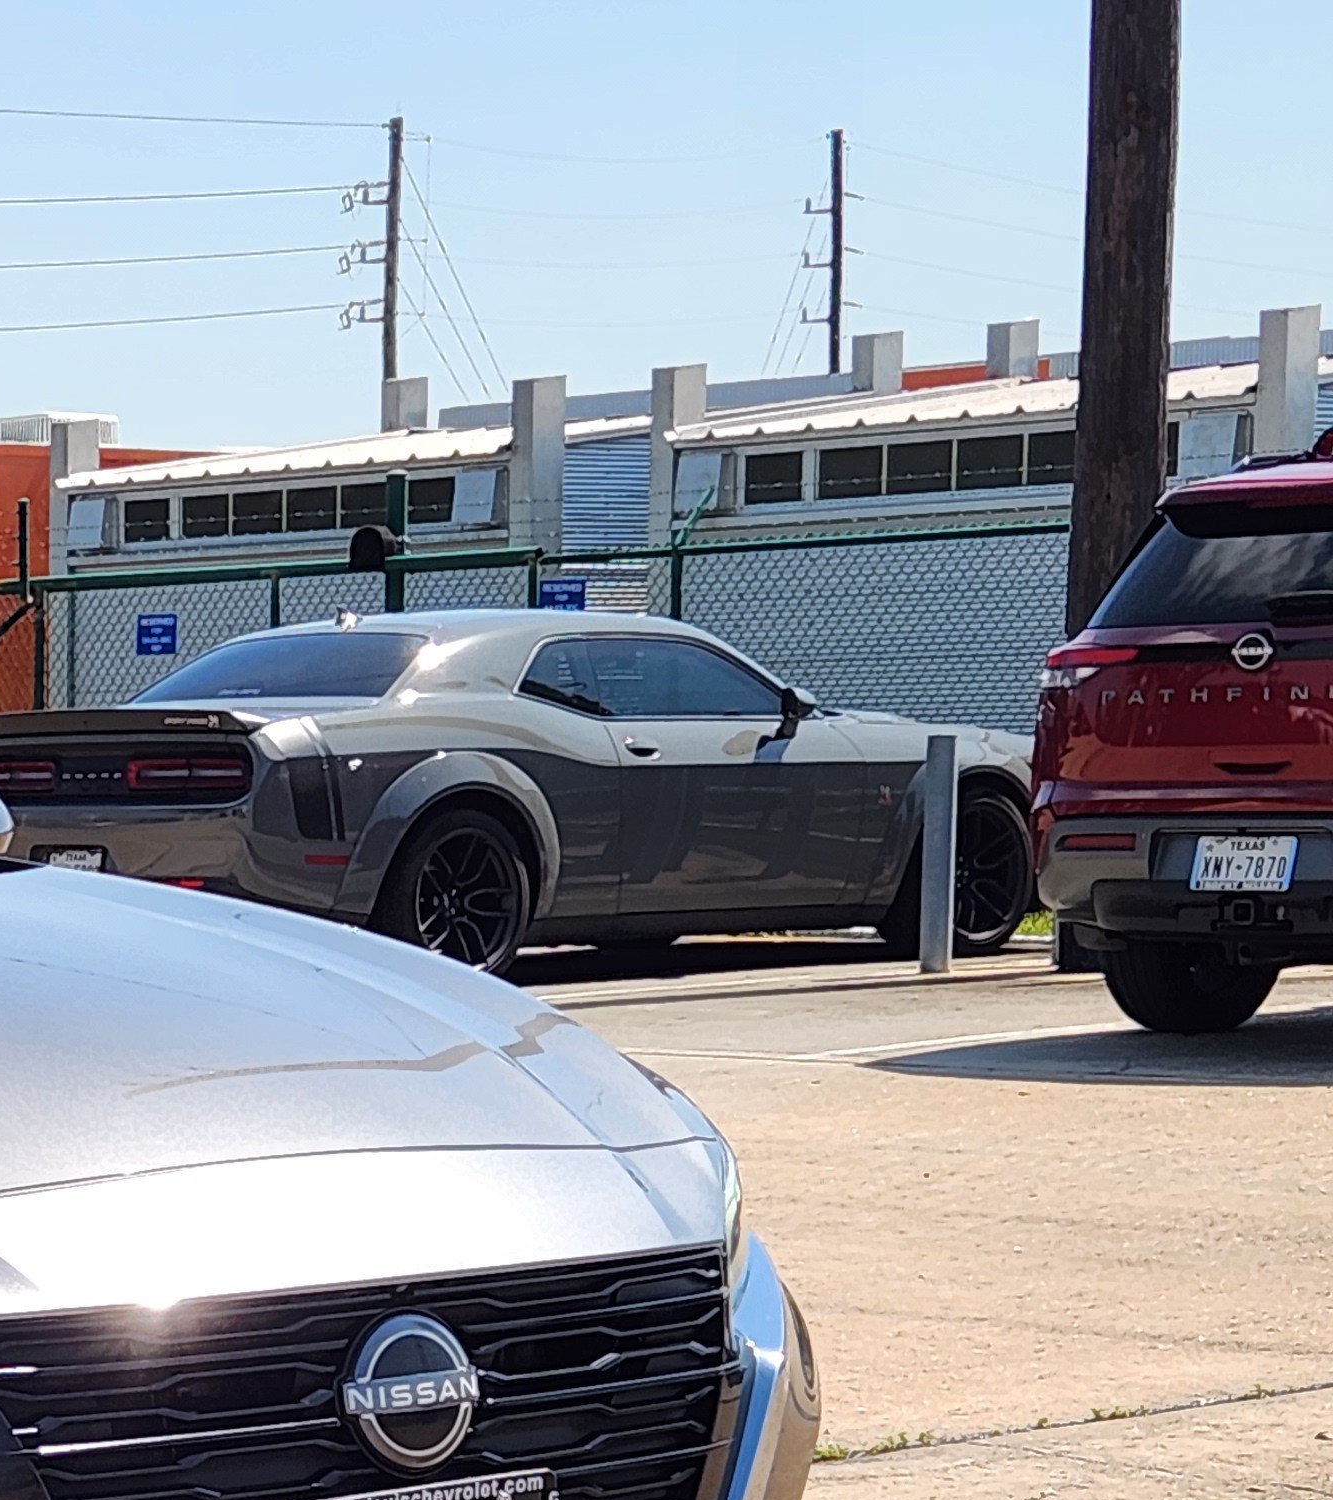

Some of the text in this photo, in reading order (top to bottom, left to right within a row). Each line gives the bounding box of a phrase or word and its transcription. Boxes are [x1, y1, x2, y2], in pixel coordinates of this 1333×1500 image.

[1101, 685, 1333, 706] PATHFIN
[1230, 840, 1266, 851] TEXAS
[348, 1374, 478, 1413] NISSAN
